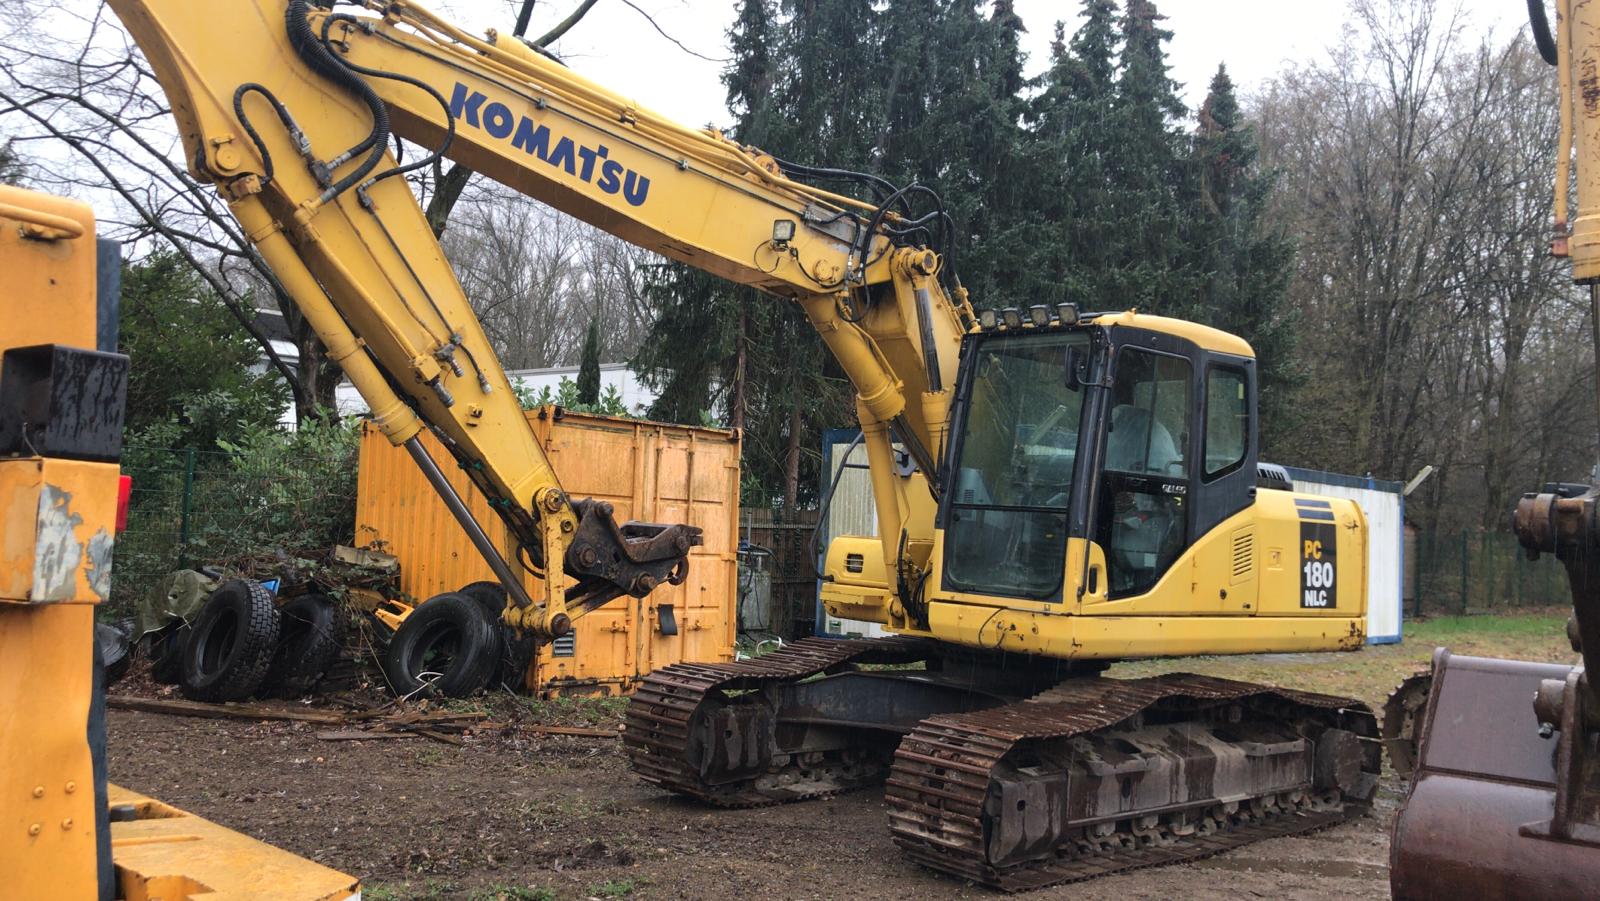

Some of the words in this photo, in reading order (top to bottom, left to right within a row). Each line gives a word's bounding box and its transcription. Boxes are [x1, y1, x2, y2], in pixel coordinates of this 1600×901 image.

[450, 82, 650, 206] KOMATSU
[1304, 540, 1321, 559] PC
[1304, 562, 1333, 588] 180
[1304, 590, 1327, 606] NLC
